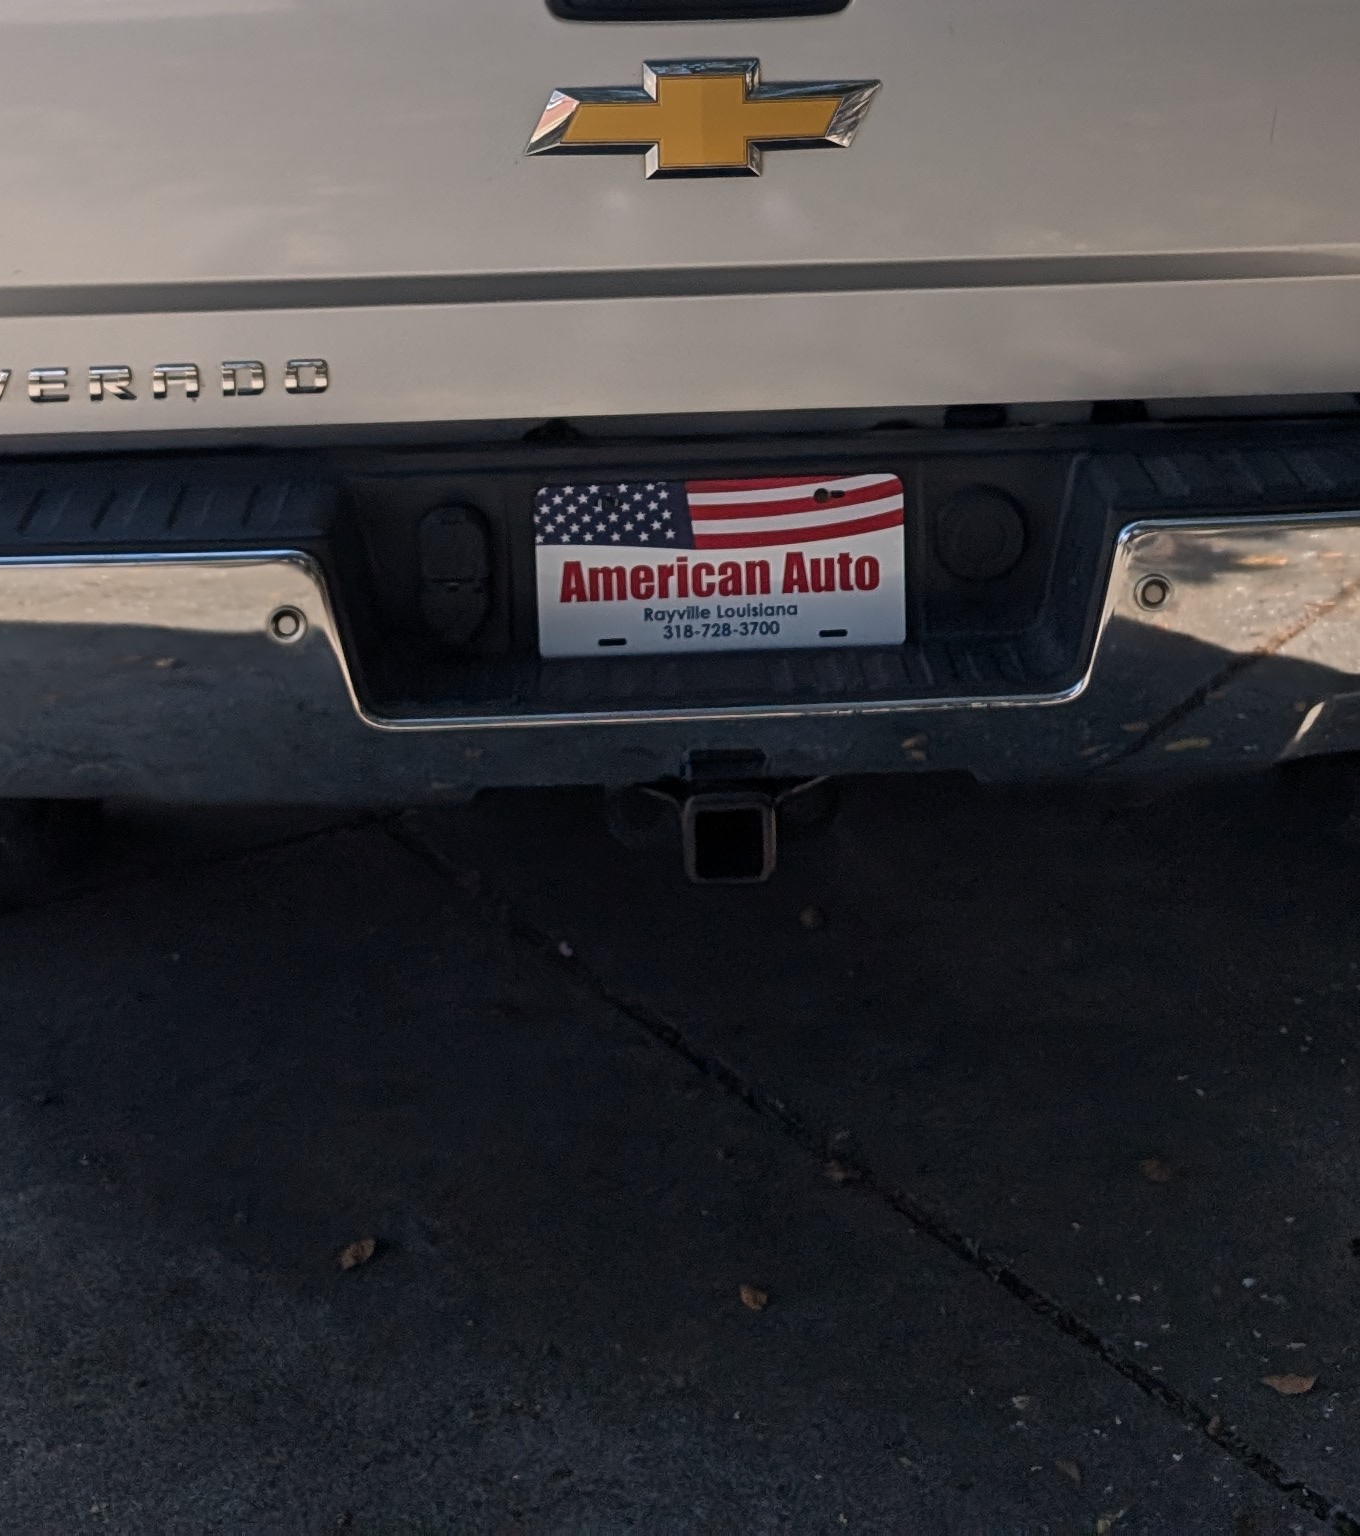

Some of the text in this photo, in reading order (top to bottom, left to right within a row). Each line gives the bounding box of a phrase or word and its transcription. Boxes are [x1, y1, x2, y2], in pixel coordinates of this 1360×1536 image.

[559, 551, 881, 603] American Auto
[643, 602, 798, 624] Rayville Louisiana
[662, 621, 781, 640] 318-728-3700
